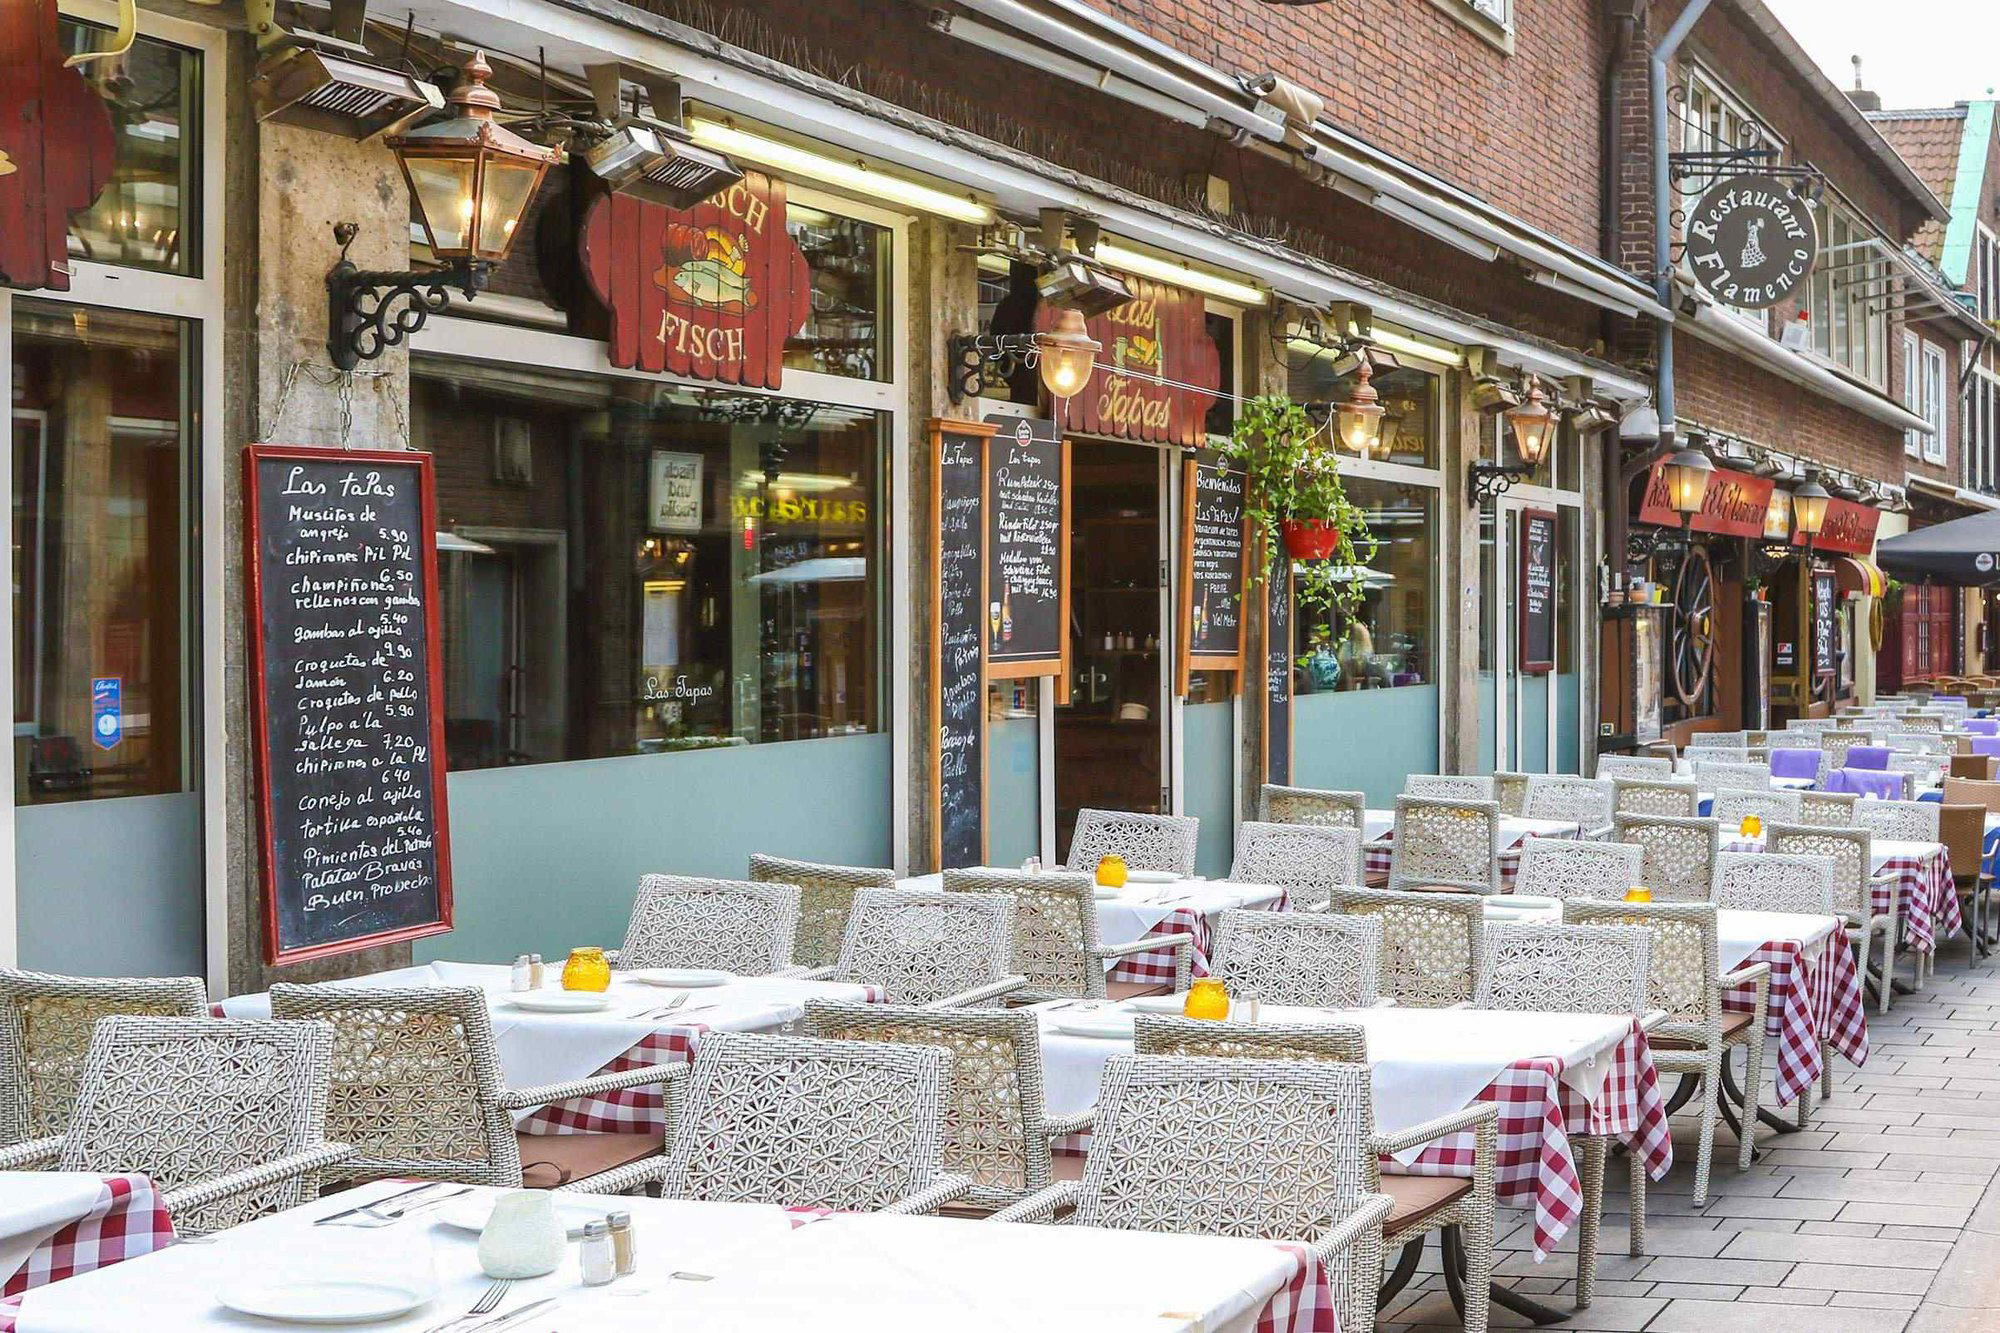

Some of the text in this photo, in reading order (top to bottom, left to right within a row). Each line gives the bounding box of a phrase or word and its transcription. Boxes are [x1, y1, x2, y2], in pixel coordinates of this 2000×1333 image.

[1692, 188, 1808, 244] Restaurant
[1694, 249, 1808, 302] Flamenco
[656, 309, 747, 361] FISCH
[1097, 374, 1171, 432] Tapas
[282, 466, 326, 495] Las
[360, 504, 377, 522] de
[378, 528, 408, 542] 5.90
[380, 568, 413, 582] 6.50
[380, 613, 408, 625] 5.40
[372, 650, 389, 667] de
[383, 670, 414, 683] 6.20
[366, 685, 384, 703] de
[643, 675, 713, 706] Las Tapas
[385, 704, 414, 717] 5.90
[349, 719, 361, 729] a
[383, 733, 414, 750] 7.20
[372, 757, 384, 768] a
[389, 752, 406, 765] la
[357, 786, 374, 805] al
[303, 841, 378, 867] Pimientos
[302, 868, 358, 889] Patatas
[303, 889, 363, 911] Buen
